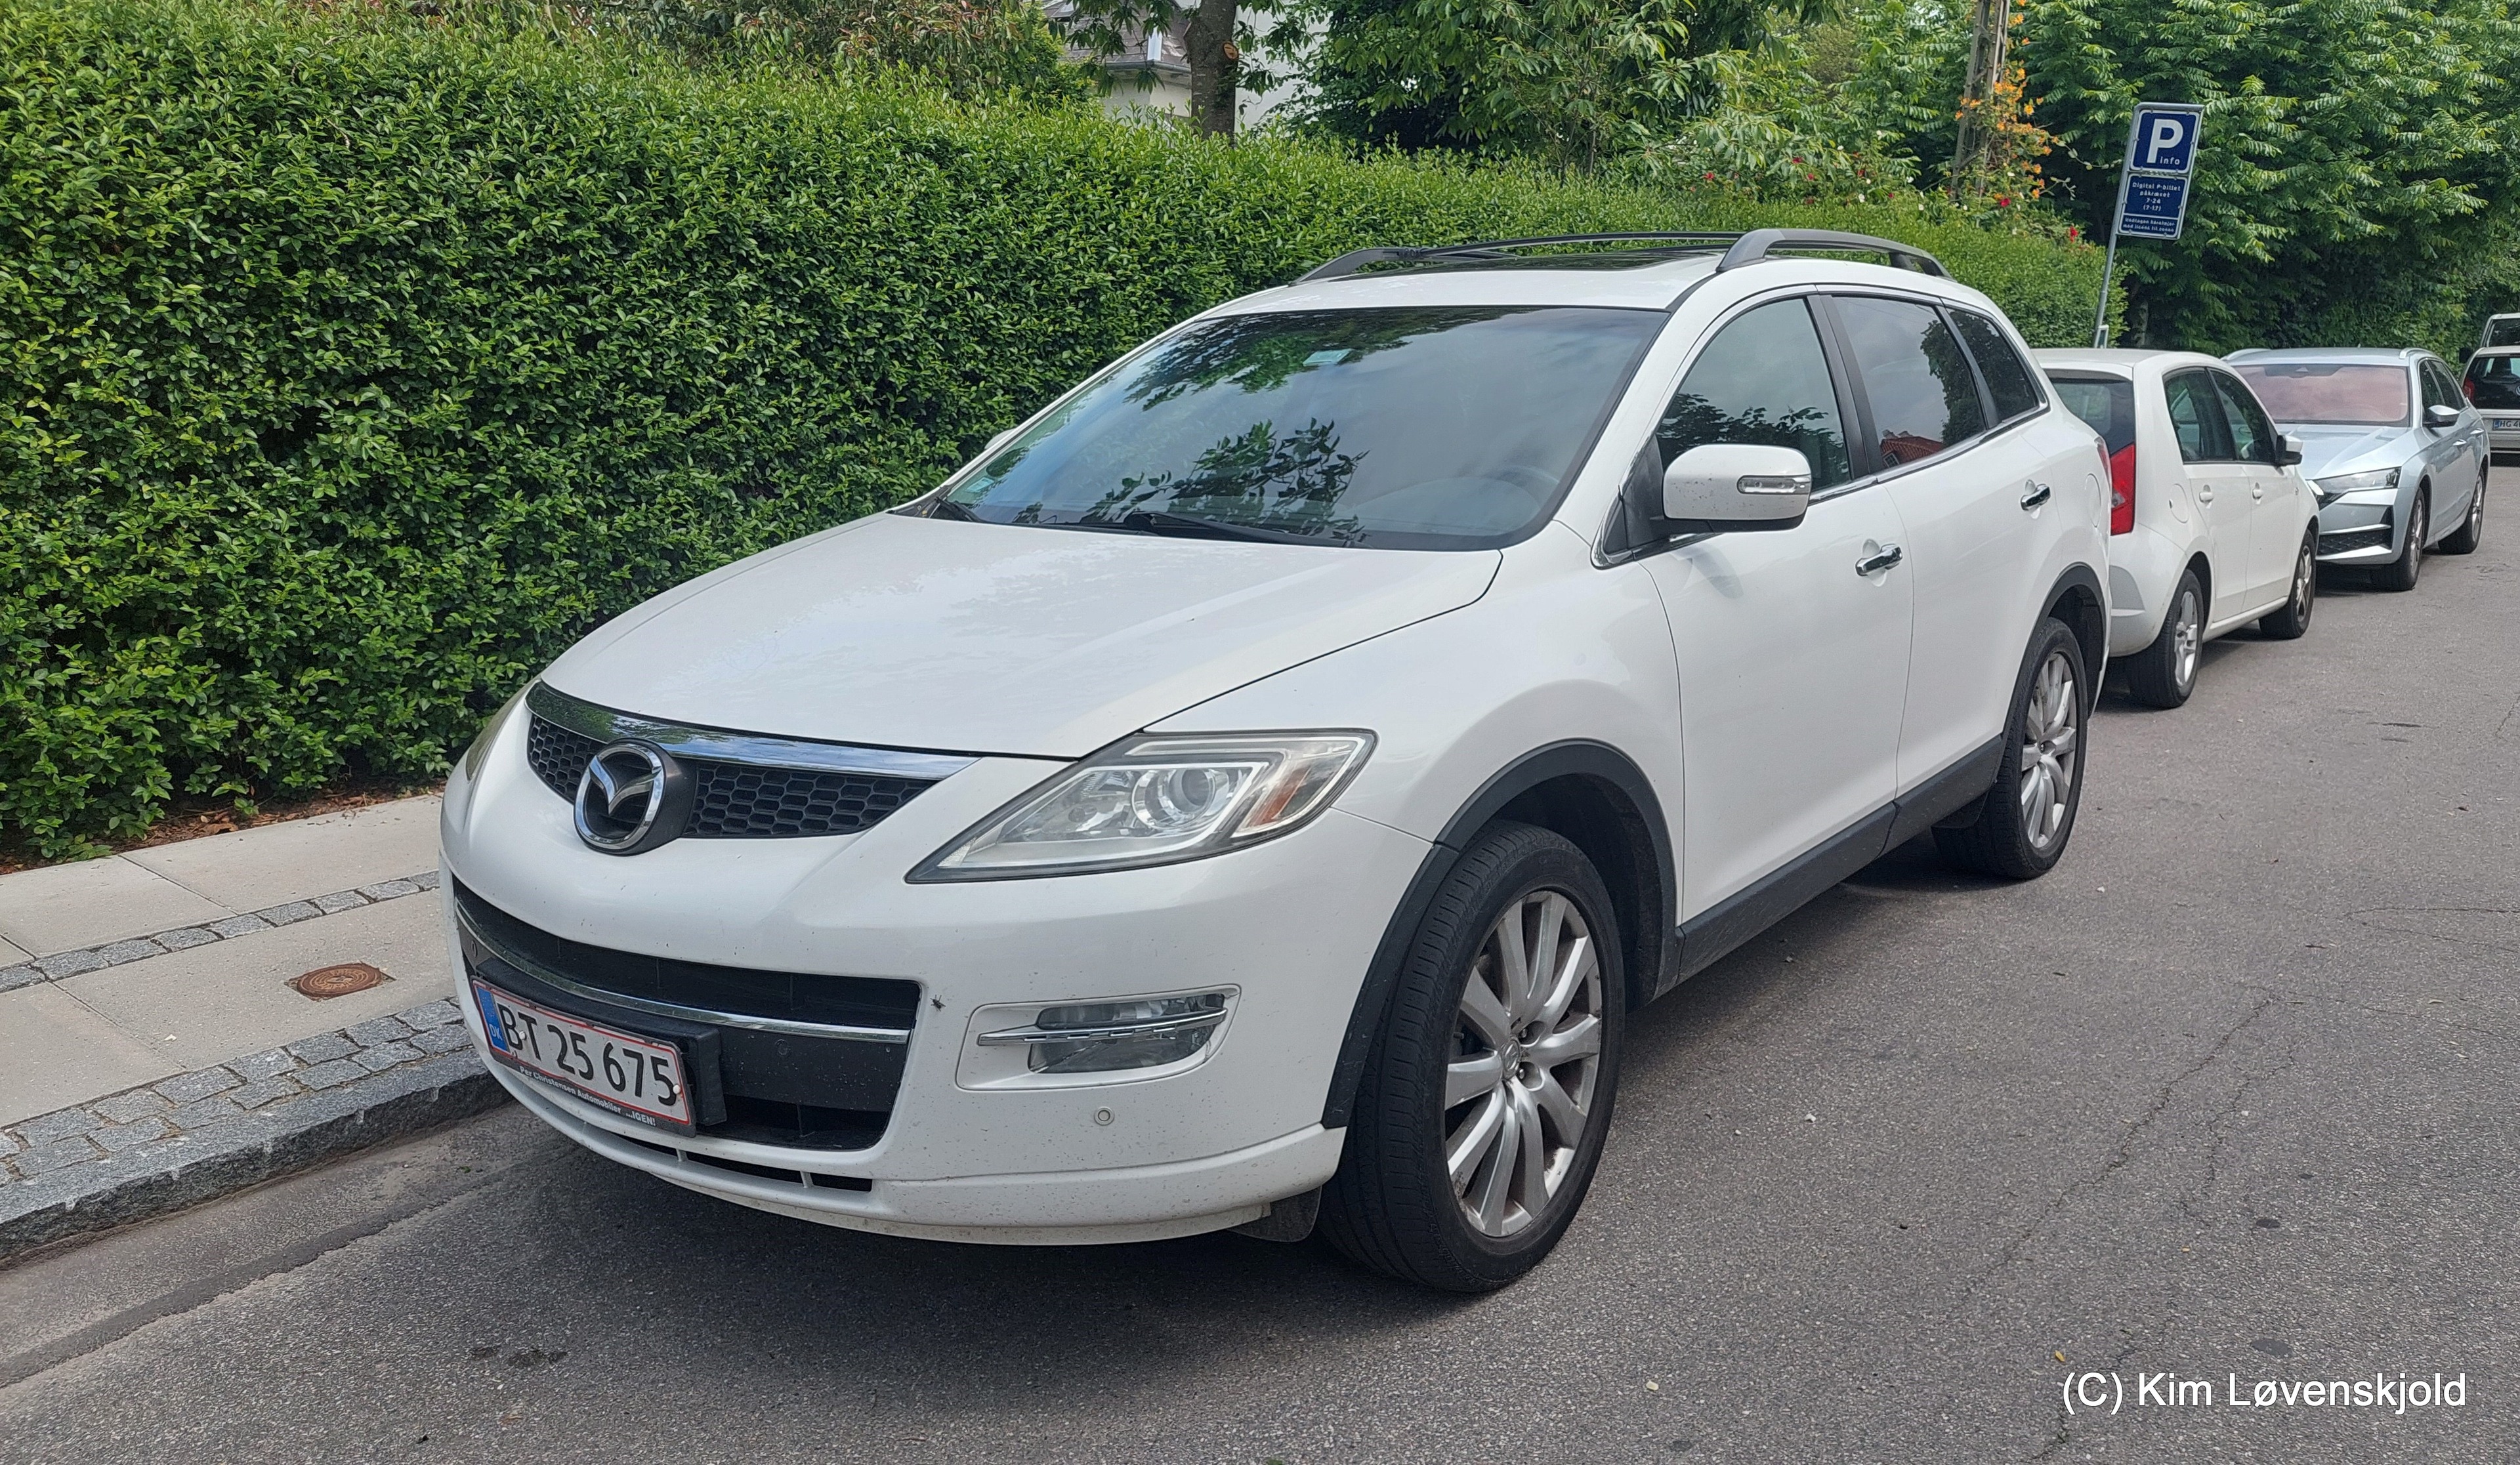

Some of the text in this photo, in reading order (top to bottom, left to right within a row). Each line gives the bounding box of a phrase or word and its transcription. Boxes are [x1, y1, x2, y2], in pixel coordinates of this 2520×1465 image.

[2147, 119, 2183, 163] P
[2160, 155, 2180, 165] info
[489, 1023, 503, 1042] DK
[497, 1003, 677, 1106] BT 25 675
[520, 1065, 533, 1077] Per
[534, 1072, 577, 1096] Christensen
[578, 1088, 621, 1115] Automobiler
